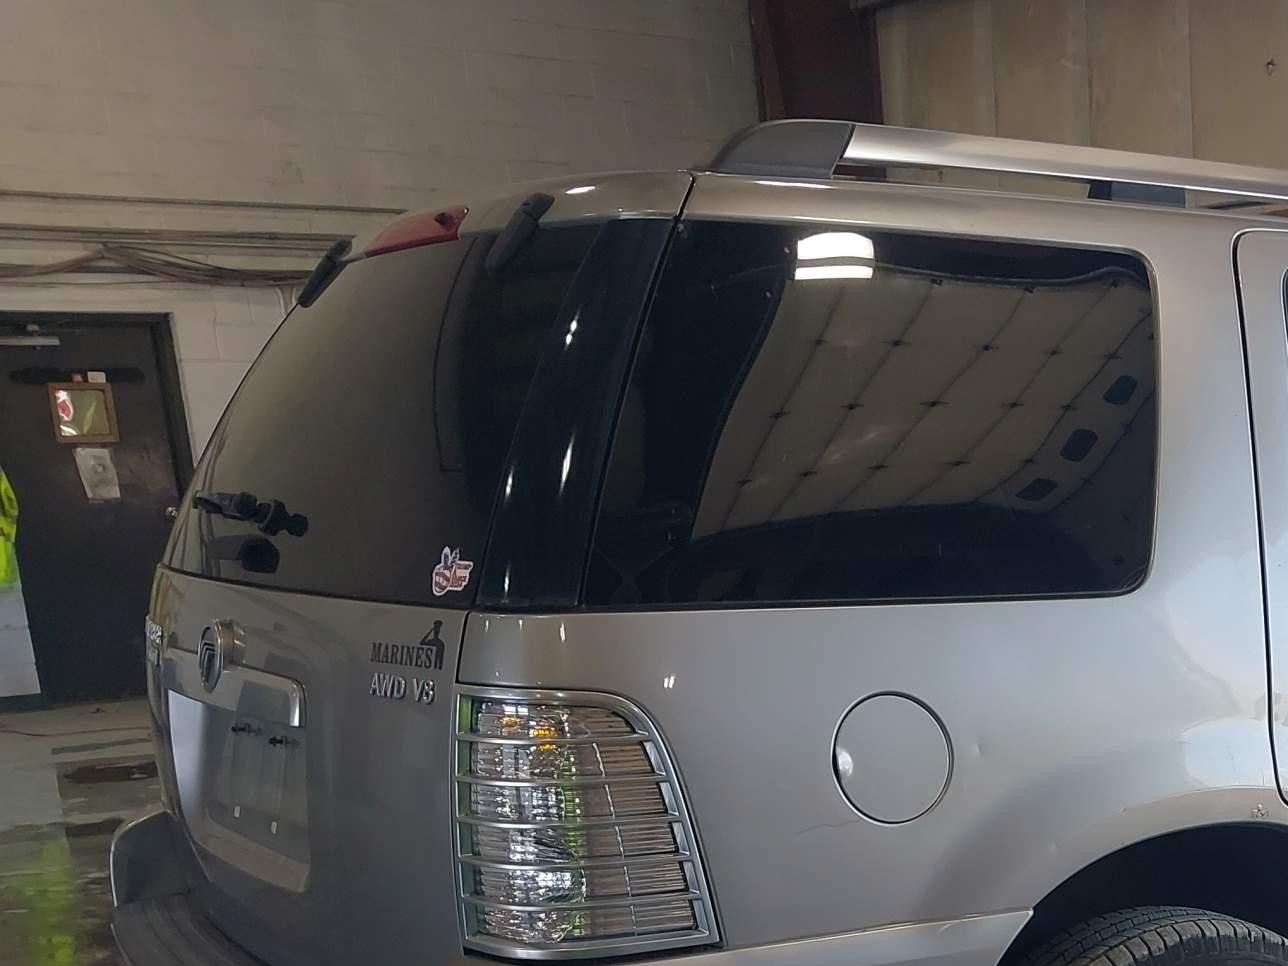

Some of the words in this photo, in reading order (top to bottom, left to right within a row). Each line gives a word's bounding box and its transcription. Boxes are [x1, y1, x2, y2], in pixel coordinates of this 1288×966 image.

[371, 642, 433, 669] MARINES
[371, 673, 406, 699] AWD
[413, 678, 436, 705] V8
